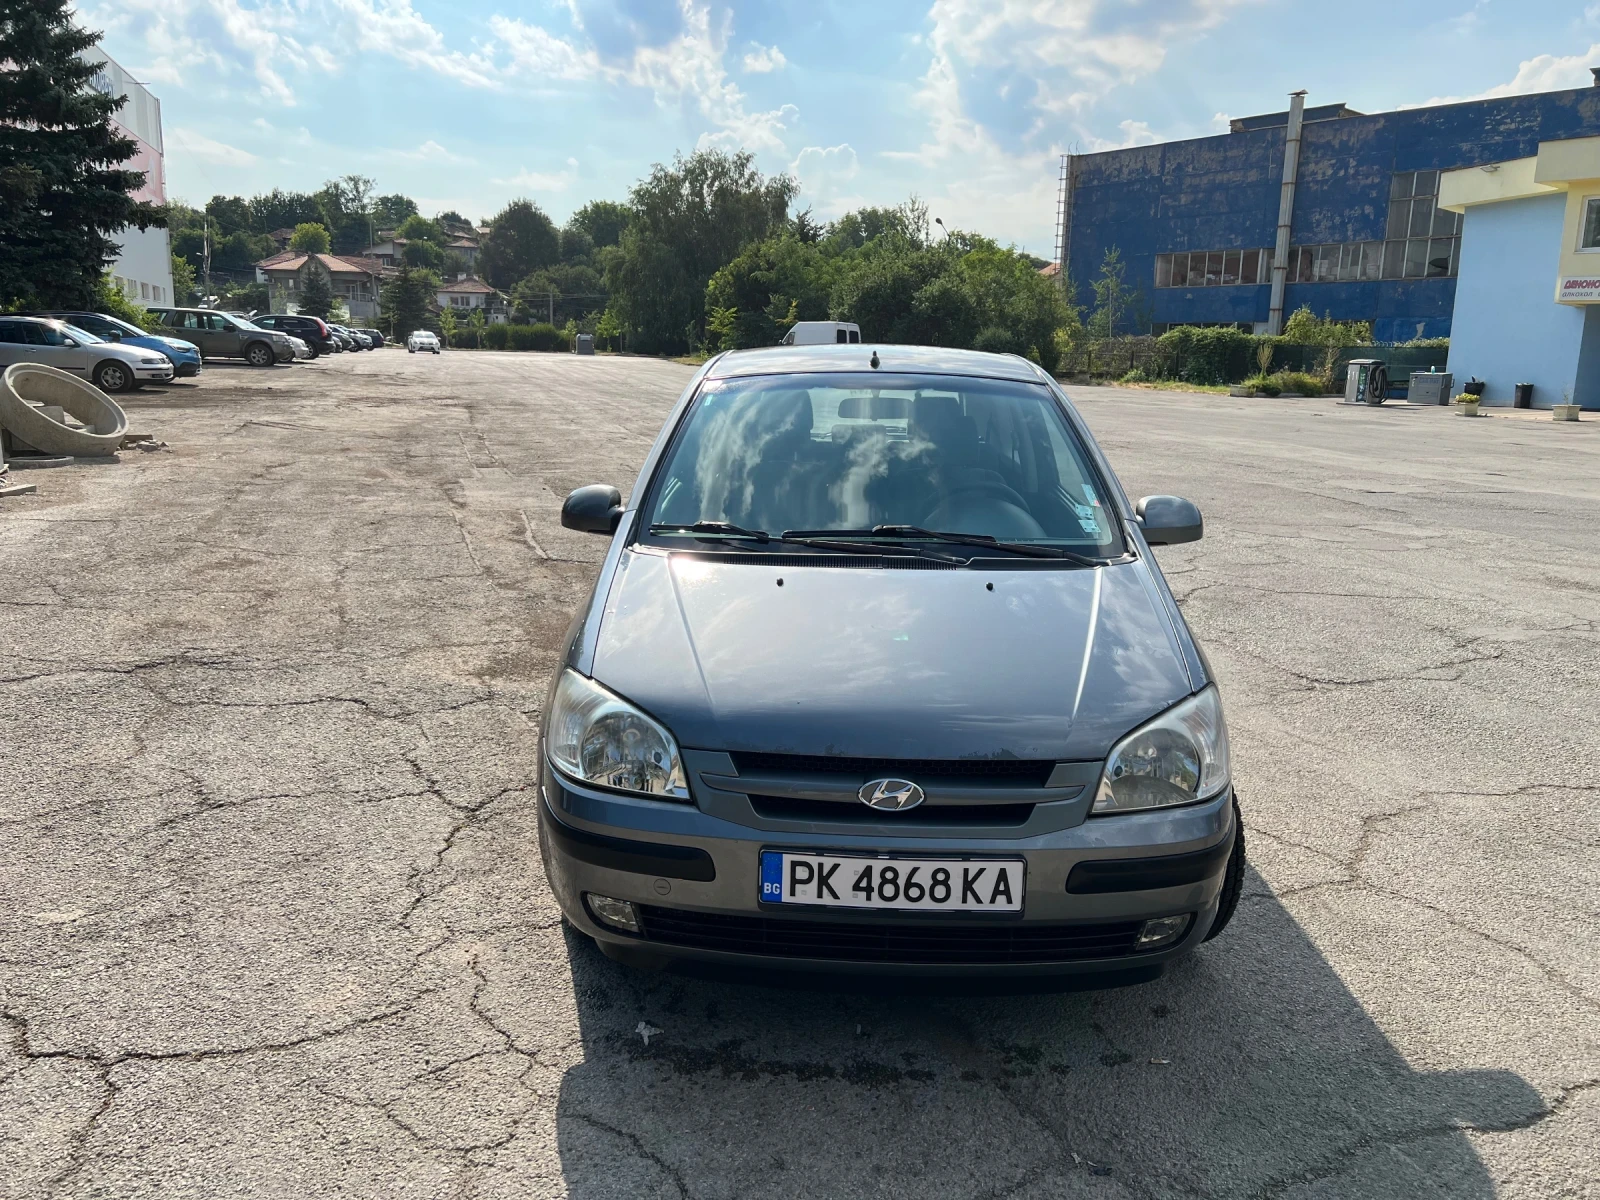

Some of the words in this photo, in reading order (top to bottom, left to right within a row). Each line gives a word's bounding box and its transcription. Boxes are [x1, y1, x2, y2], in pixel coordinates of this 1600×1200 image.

[764, 883, 781, 895] BG
[789, 860, 841, 900] PK
[852, 865, 952, 904] 4868
[961, 867, 1014, 905] KA
